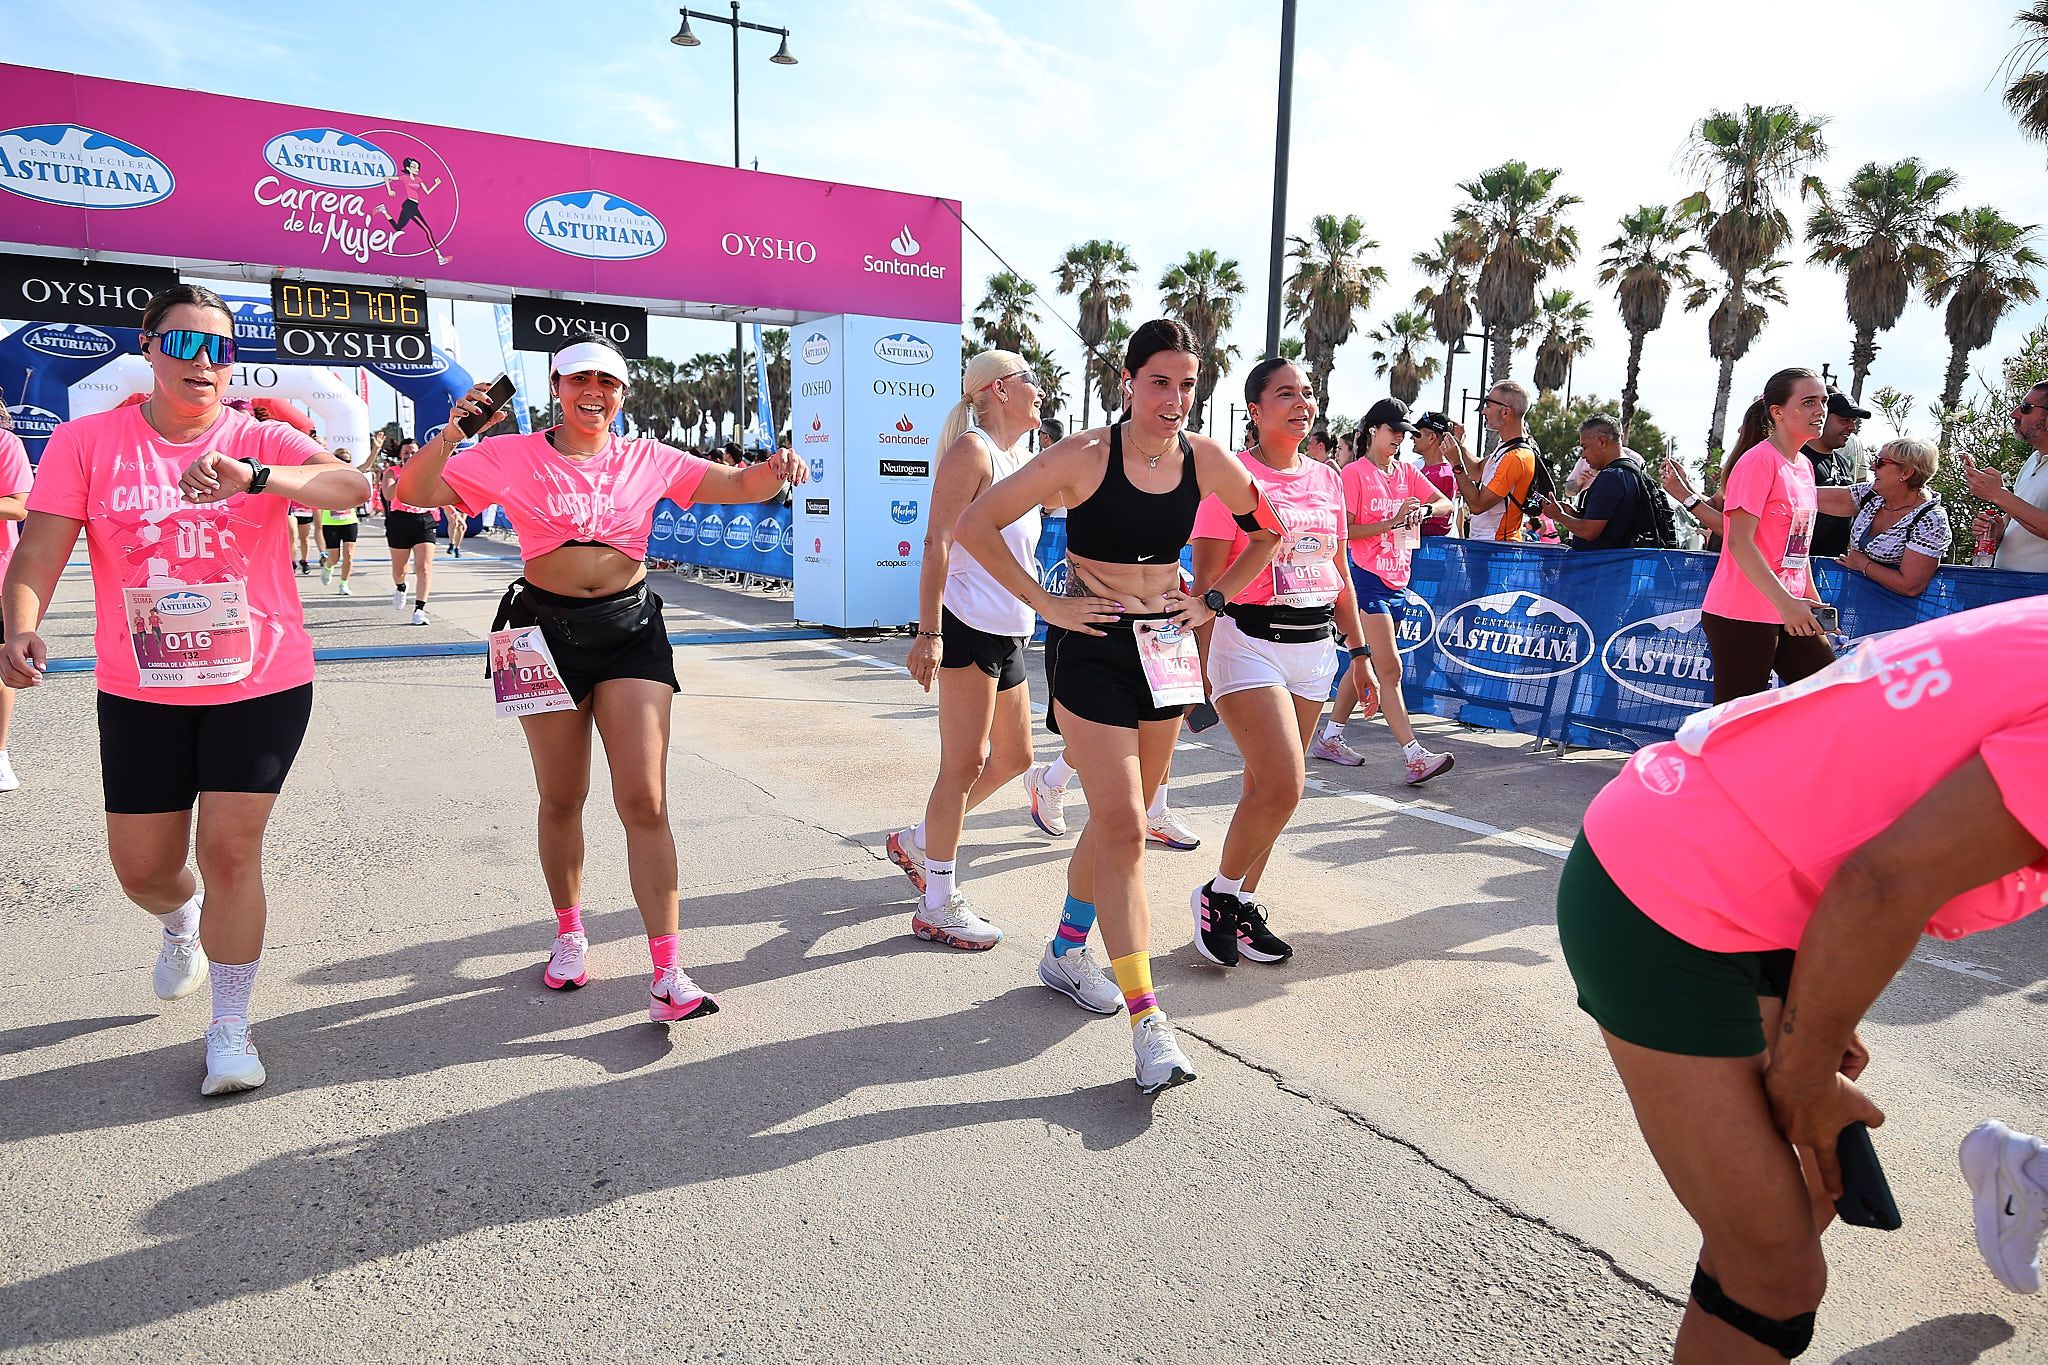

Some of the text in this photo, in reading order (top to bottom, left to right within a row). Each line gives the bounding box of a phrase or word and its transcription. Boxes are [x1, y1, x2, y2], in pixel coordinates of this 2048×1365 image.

[19, 147, 152, 170] CENTRAL LECHERA
[275, 143, 386, 178] ASTURIANA
[294, 143, 383, 161] CENTRAL LECHERA
[254, 175, 365, 217] Carrera
[558, 210, 651, 227] CENTRAL LECHERA
[283, 210, 405, 264] de la Mujer
[537, 210, 656, 247] ASTURIANA
[721, 232, 817, 264] OYSHO
[863, 254, 946, 280] Santander
[22, 278, 153, 311] OYSHO
[283, 285, 419, 325] 00:37:06
[534, 314, 631, 343] OYSHO
[29, 332, 109, 352] ASTURIANA
[283, 329, 426, 361] OYSHO
[878, 342, 929, 359] ASTURIANA
[78, 383, 119, 392] OYSHO
[802, 379, 832, 398] OYSHO
[873, 379, 935, 398] OYSHO
[879, 433, 930, 445] Santander
[882, 462, 927, 476] Neutrogena
[177, 520, 216, 560] DE
[876, 559, 907, 569] octopus
[1294, 565, 1321, 579] 016
[160, 600, 208, 611] ASTURIANA
[1473, 616, 1579, 636] CENTRAL LECHERA
[165, 631, 213, 650] 016
[1444, 615, 1578, 664] ASTURIANA
[1649, 636, 1709, 651] CENTRAL
[182, 651, 200, 660] 132
[213, 656, 242, 665] VALENCIA
[1612, 635, 1714, 682] ASTUR
[151, 673, 183, 681] OYSHO
[519, 664, 555, 682] 016
[531, 682, 549, 690] 2504
[505, 702, 535, 712] OYSHO
